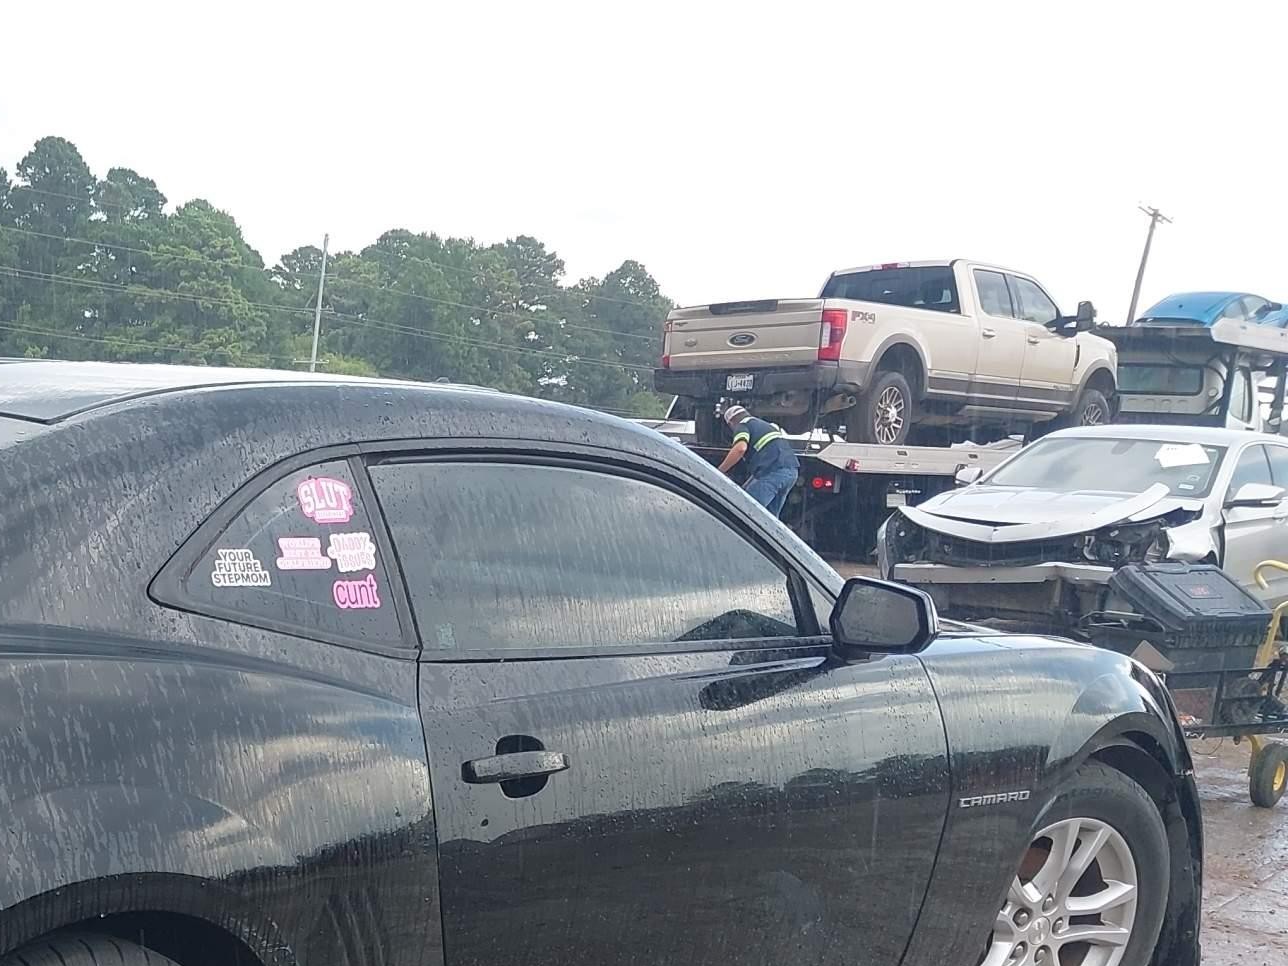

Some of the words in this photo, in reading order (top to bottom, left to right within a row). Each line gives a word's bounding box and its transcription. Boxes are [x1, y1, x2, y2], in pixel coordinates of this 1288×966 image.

[851, 310, 876, 325] FX4
[300, 480, 349, 513] SLUT
[219, 551, 252, 561] YOUR
[216, 562, 261, 573] FUTURE
[213, 573, 269, 584] STEPMOM
[335, 577, 378, 605] cunt
[959, 790, 1031, 808] CAMARO
